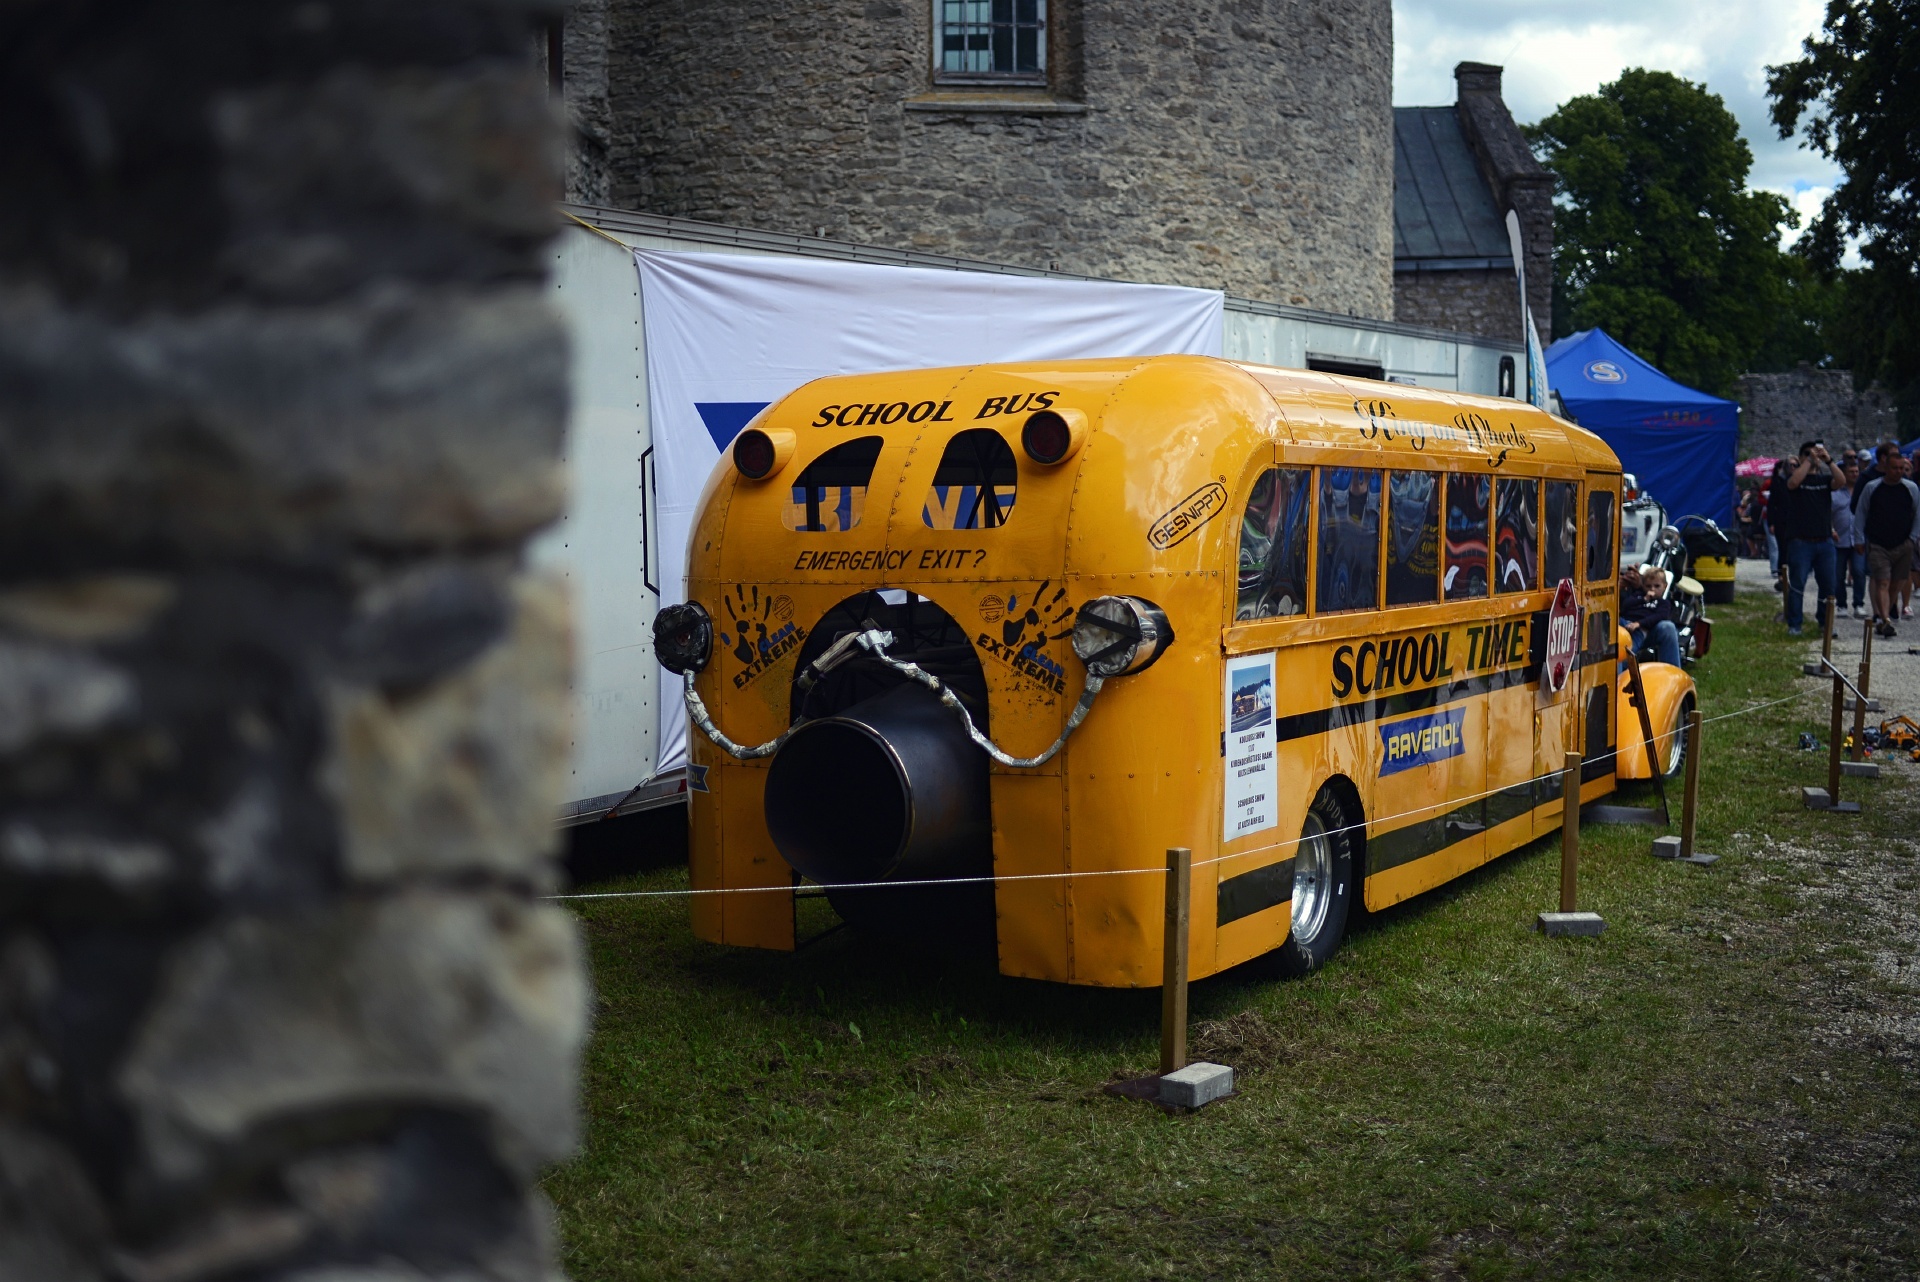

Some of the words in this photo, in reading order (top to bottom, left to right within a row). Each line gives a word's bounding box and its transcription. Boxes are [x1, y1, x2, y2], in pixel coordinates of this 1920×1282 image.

[812, 400, 954, 428] SCHOOL
[974, 391, 1061, 420] BUS
[1353, 399, 1425, 451] King
[1432, 422, 1457, 441] on
[1454, 412, 1536, 466] Wheels
[1153, 487, 1222, 545] GESNIPPT
[794, 550, 912, 571] EMERGENCY
[760, 621, 796, 652] CLEAN
[1550, 614, 1575, 656] STOP
[733, 626, 808, 689] EXTREME
[976, 632, 1066, 695] EXTREME
[1023, 645, 1064, 678] CLEAN
[1331, 631, 1454, 699] SCHOOL
[1466, 619, 1527, 672] TIME
[1388, 722, 1460, 762] RAVENOL
